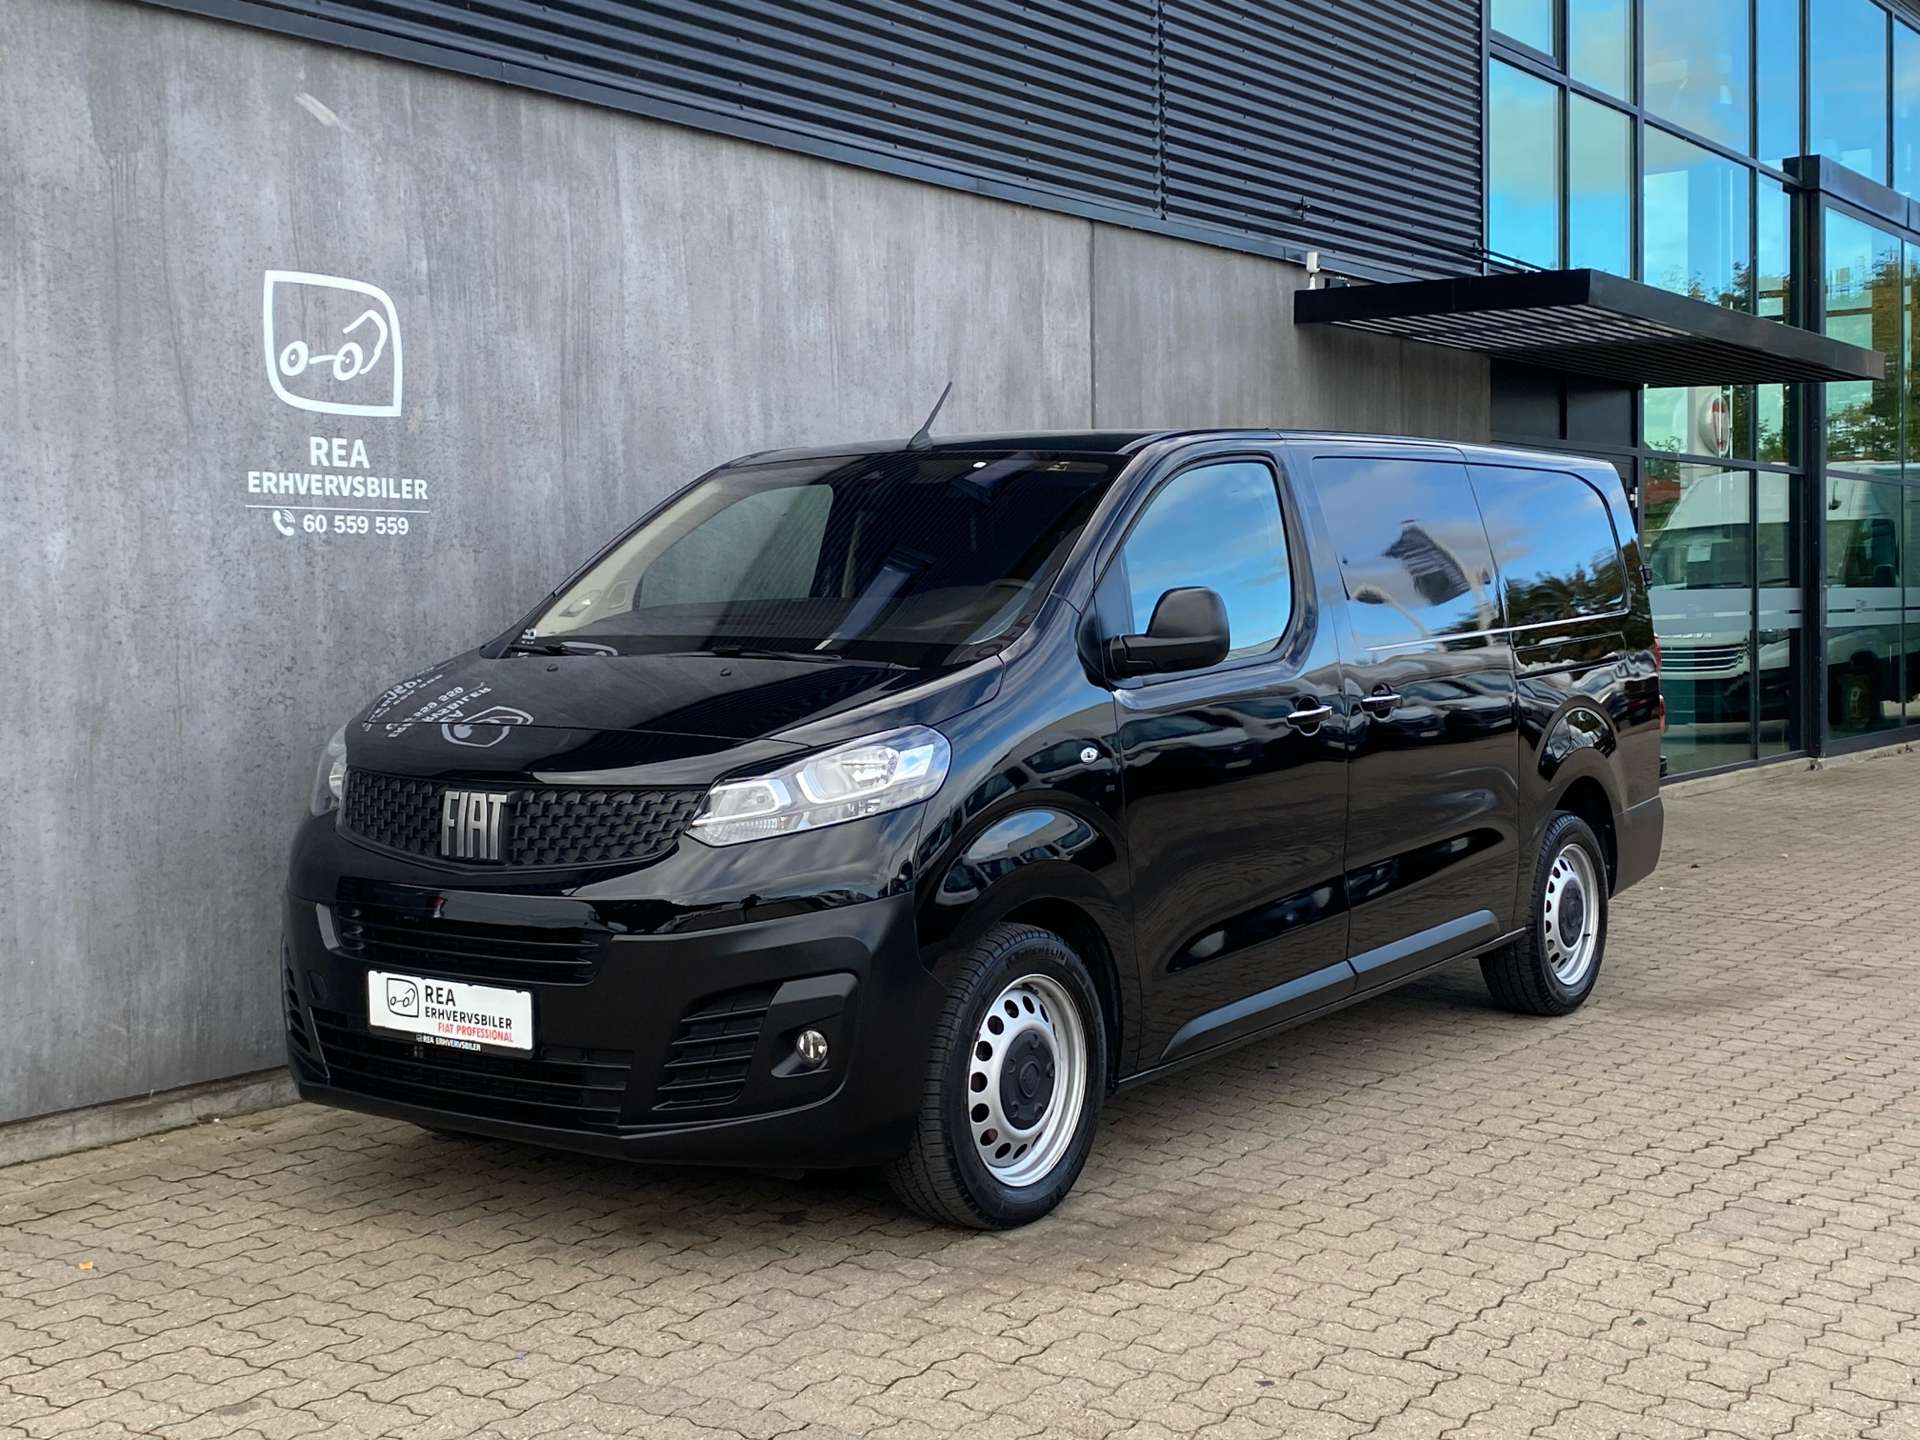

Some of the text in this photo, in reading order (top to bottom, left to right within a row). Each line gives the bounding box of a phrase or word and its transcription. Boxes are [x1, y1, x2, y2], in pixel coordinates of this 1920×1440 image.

[310, 436, 370, 468] REA
[248, 471, 428, 499] ERHVERVSBILER
[303, 514, 409, 535] 60 559 559
[441, 790, 508, 860] FIAT
[425, 985, 456, 1007] REA
[425, 1006, 512, 1030] ERHVERVSBILER
[423, 1035, 434, 1044] REA
[438, 1022, 513, 1043] FIAT PROFESSIONAL
